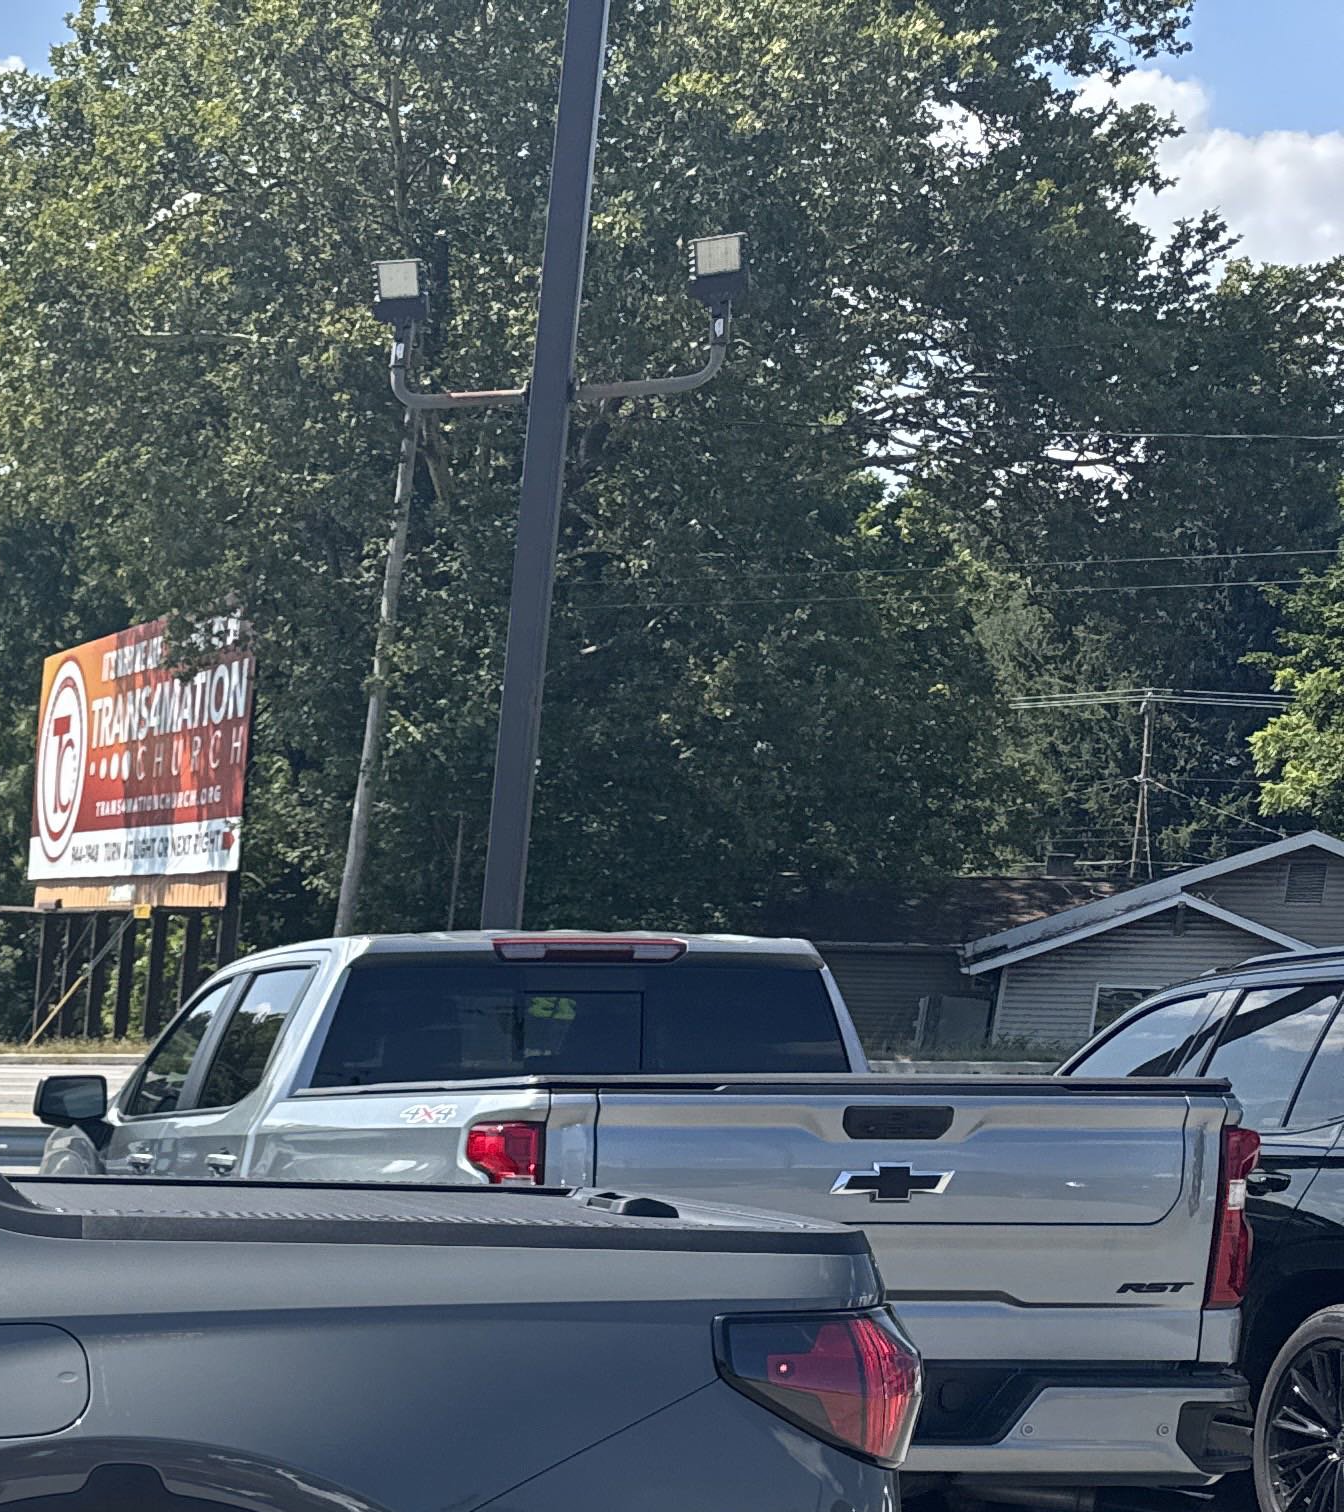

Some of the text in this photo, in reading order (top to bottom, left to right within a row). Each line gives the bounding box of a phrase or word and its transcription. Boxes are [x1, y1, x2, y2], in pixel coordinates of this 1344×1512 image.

[91, 658, 250, 749] TRANS4MATION
[136, 726, 244, 781] CHURCH
[170, 833, 192, 857] NEXT
[1115, 1282, 1195, 1293] RST
